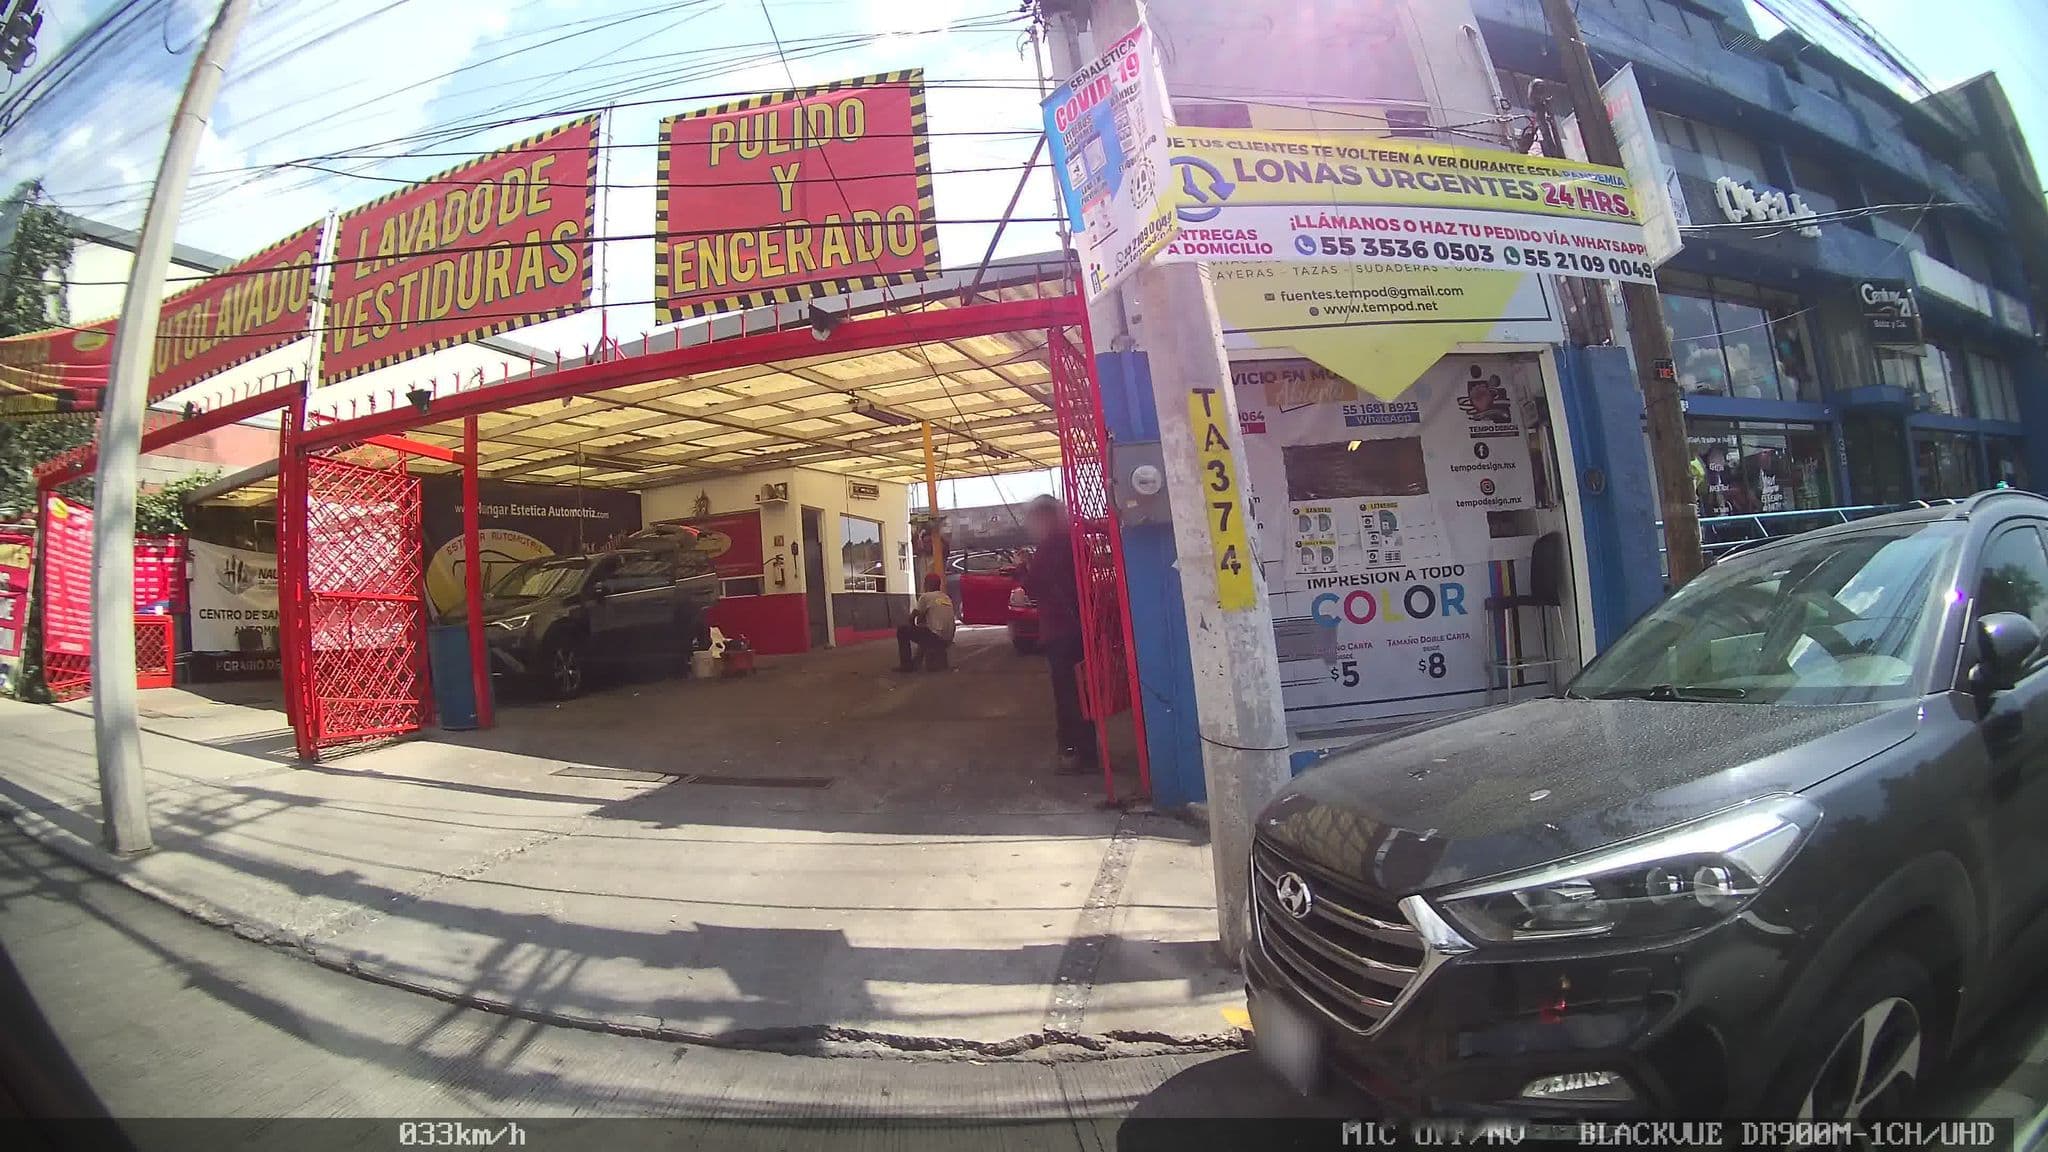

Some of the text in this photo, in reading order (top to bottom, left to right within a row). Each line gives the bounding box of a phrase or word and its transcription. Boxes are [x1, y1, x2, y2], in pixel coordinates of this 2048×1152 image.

[1055, 53, 1139, 132] COVID-19
[708, 97, 866, 167] PULIDO
[1187, 138, 1224, 149] TUS
[1226, 140, 1309, 156] CLIENTES
[1311, 144, 1332, 158] TE
[1335, 147, 1410, 164] VOLTEEN
[1413, 154, 1424, 166] A
[1428, 155, 1458, 169] VER
[1459, 158, 1526, 176] DURANTE
[1527, 166, 1562, 178] ESTA
[771, 162, 801, 212] Y
[1232, 157, 1637, 218] LONAS URGENTES 24 HRS.
[353, 152, 556, 281] LAVADO DE
[1290, 211, 1400, 232] ¡LLÁMANOS
[1403, 220, 1417, 232] O
[1419, 220, 1457, 236] HAZ
[1459, 223, 1481, 237] TU
[1484, 226, 1542, 243] PEDIDO
[1167, 242, 1273, 255] A DOMICILIO
[1175, 229, 1258, 241] NTREGAS
[672, 204, 918, 295] ENCERADO
[1320, 236, 1495, 264] 55 3536 0503
[1524, 248, 1654, 279] 55 2109 0049
[1216, 267, 1275, 280] AYERAS
[1293, 265, 1338, 276] TAZAS
[330, 218, 580, 356] VESTIDURAS
[1280, 285, 1464, 302] fuentes.tempod@gmail.com
[151, 248, 311, 376] UTOLAVADO
[1323, 300, 1439, 315] www.tempod.net
[1231, 371, 1277, 386] VICIO
[1450, 461, 1517, 473] tempodesign.mx
[510, 503, 547, 517] Estetica
[548, 505, 610, 519] Automotriz.com
[1456, 496, 1523, 508] tempodesign.mx
[1405, 569, 1417, 581] A
[1423, 564, 1465, 580] TODO
[199, 608, 242, 620] CENTRO
[245, 609, 259, 620] DE
[1311, 581, 1469, 629] COLOR
[1331, 660, 1360, 688] $5
[1418, 652, 1447, 679] $8
